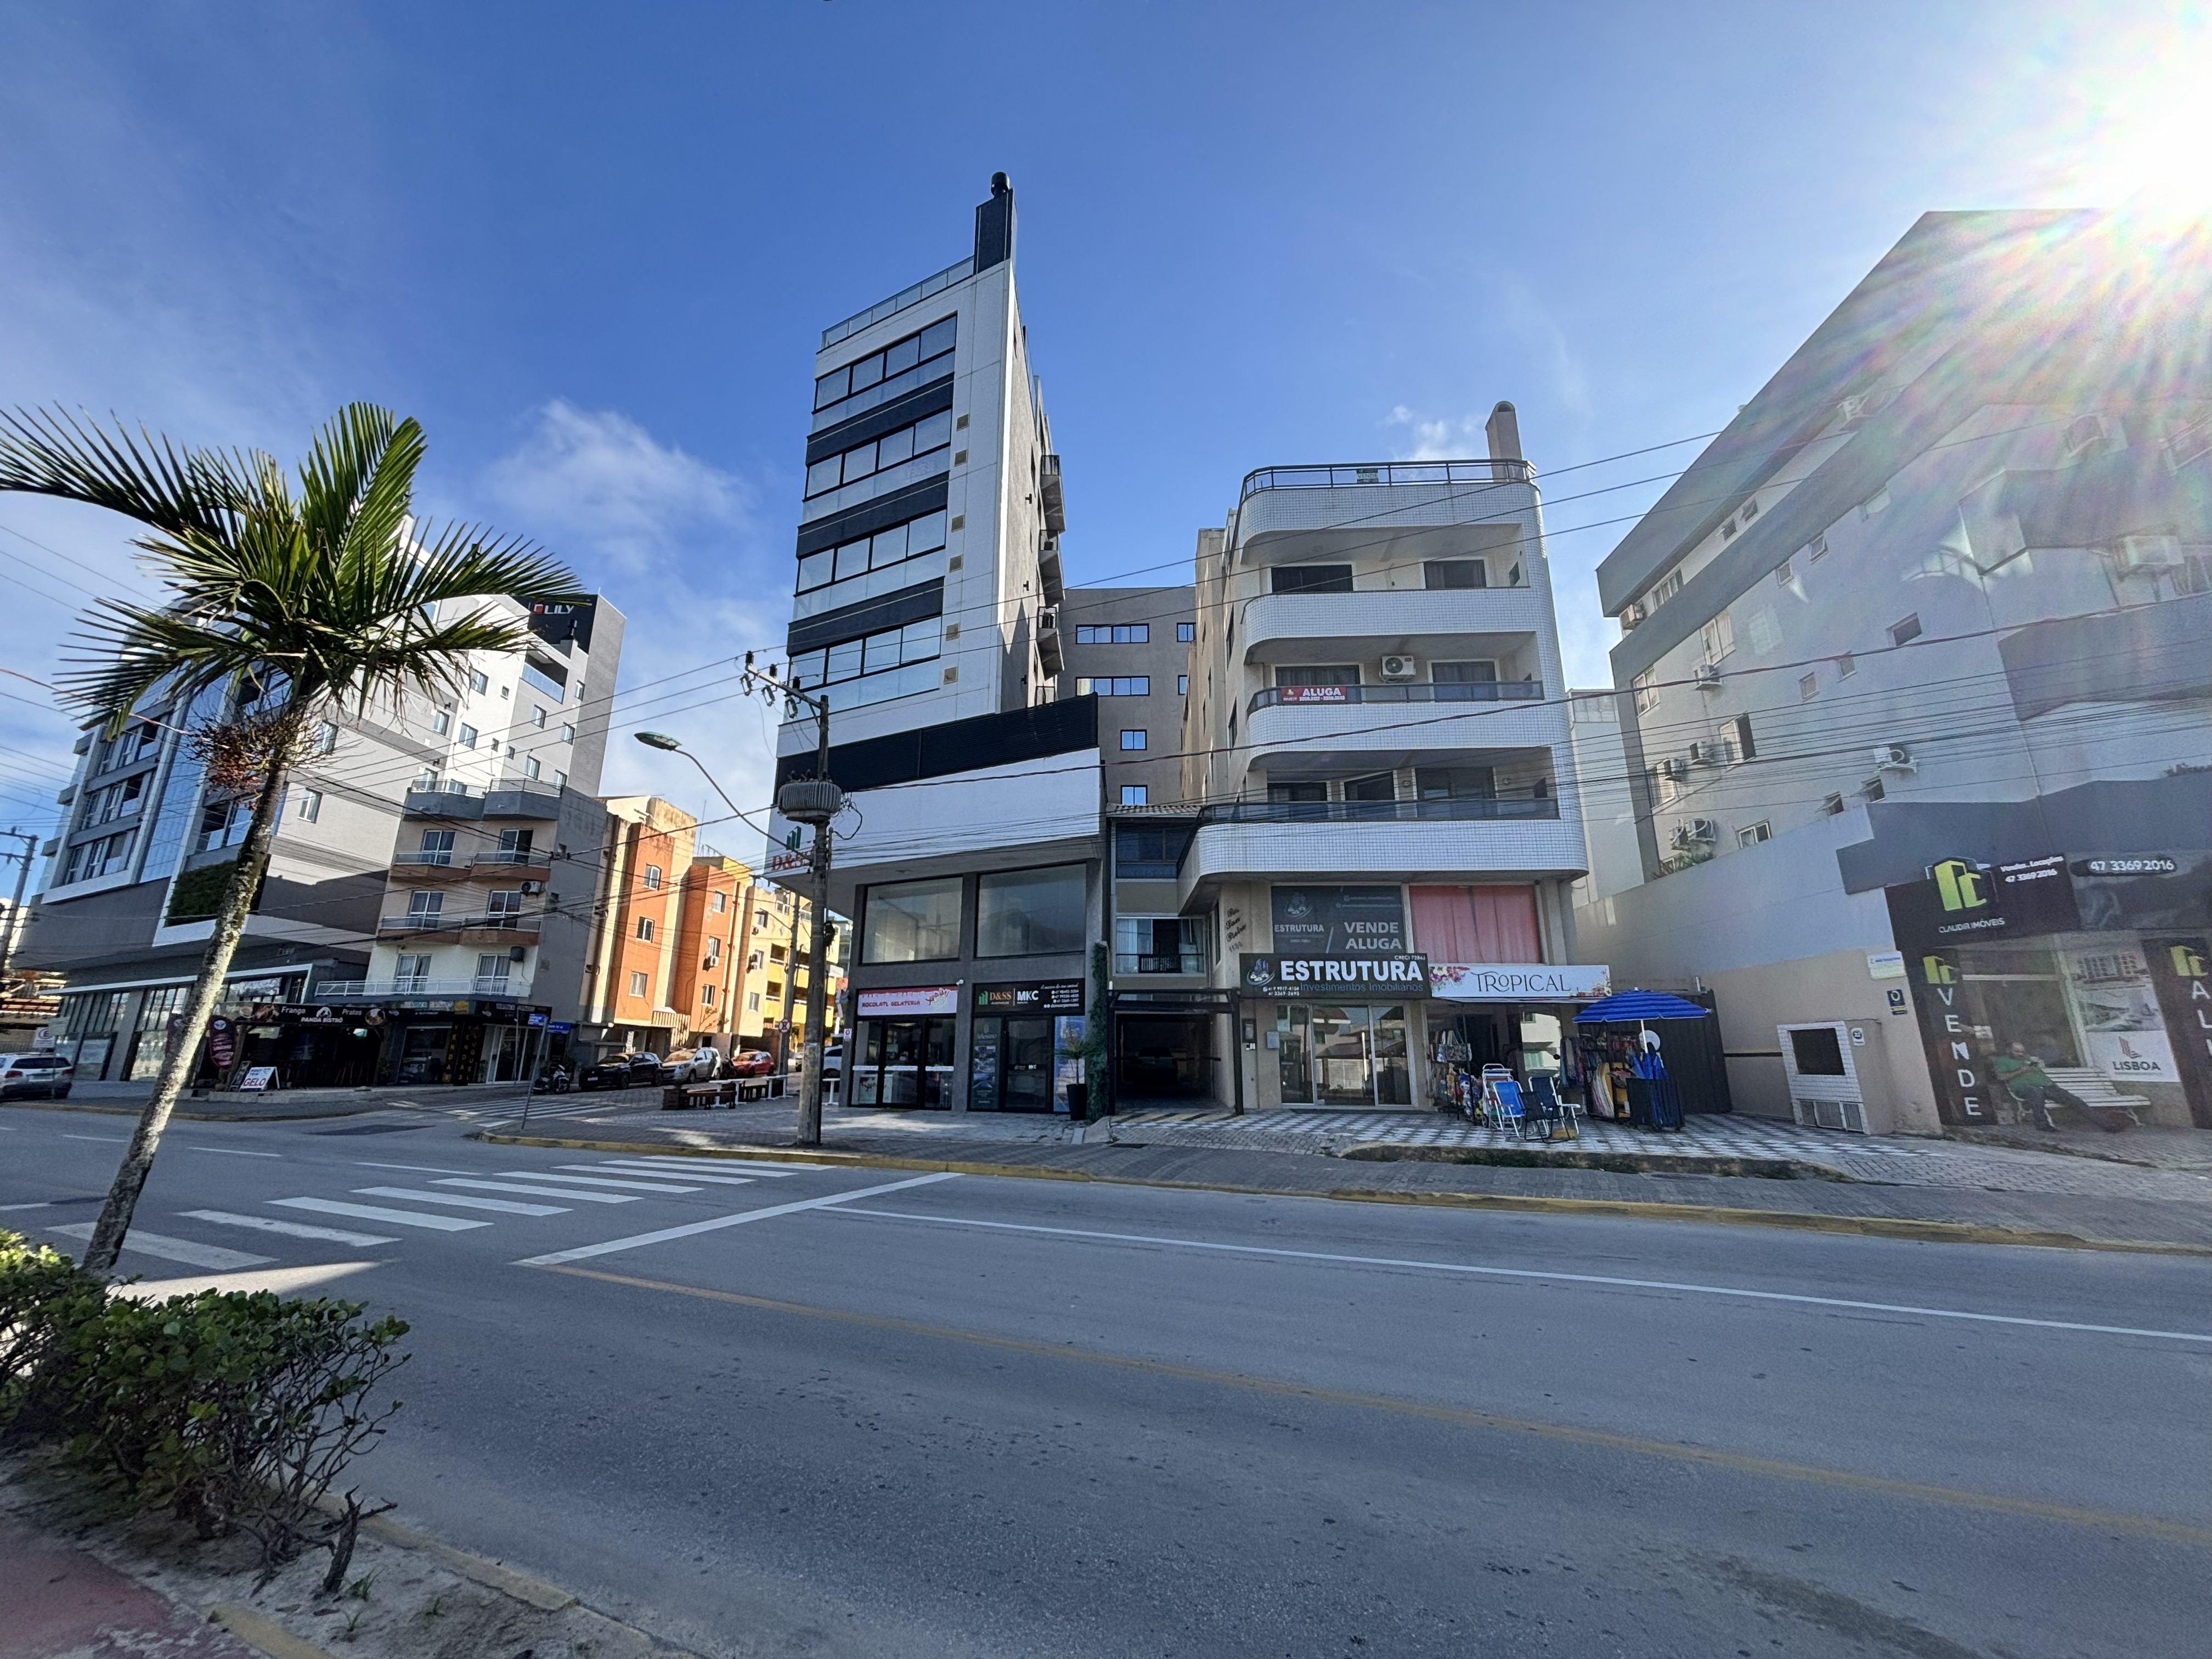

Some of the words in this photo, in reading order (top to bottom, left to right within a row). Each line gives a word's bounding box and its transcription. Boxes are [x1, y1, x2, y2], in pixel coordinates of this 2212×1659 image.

[544, 604, 575, 614] LILY
[1302, 687, 1342, 696] ALUGA
[2090, 861, 2106, 871] 47
[2110, 860, 2142, 871] 3369
[2143, 860, 2175, 871] 2016
[1274, 924, 1324, 933] ESTRUTURA
[1344, 922, 1399, 934] VENDE
[1938, 922, 1971, 934] CLAUDIR
[1970, 917, 2005, 929] IMÓVEIS
[1345, 938, 1403, 950] ALUGA
[1280, 961, 1424, 981] ESTRUTURA
[1300, 982, 1366, 992] Investimentos
[1369, 981, 1424, 992] Imobiliários
[1470, 971, 1571, 992] TROPICAL
[989, 991, 1012, 1001] D&SS
[1017, 990, 1039, 1001] MKC
[281, 1006, 306, 1015] Frango
[1937, 987, 1982, 1116] VENDE
[2112, 1060, 2162, 1071] LISBOA
[242, 1077, 267, 1087] GELO
